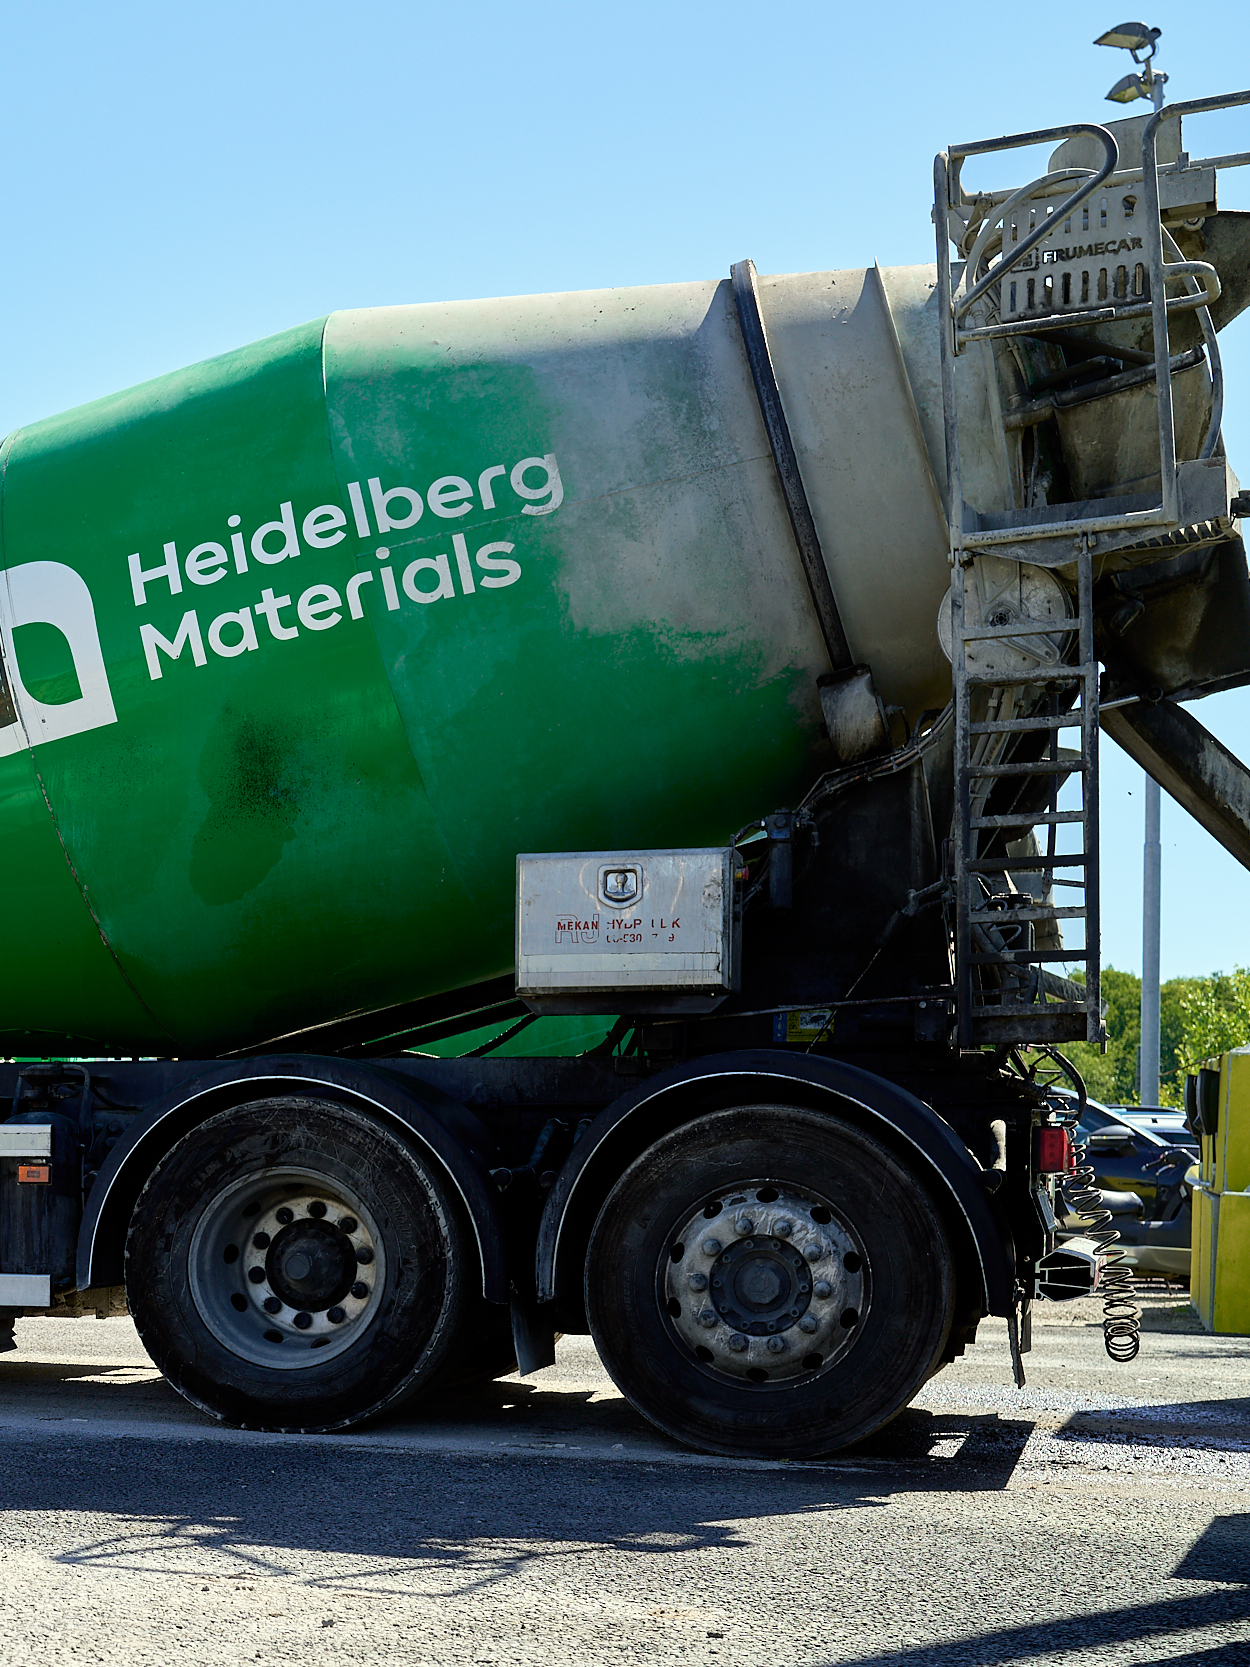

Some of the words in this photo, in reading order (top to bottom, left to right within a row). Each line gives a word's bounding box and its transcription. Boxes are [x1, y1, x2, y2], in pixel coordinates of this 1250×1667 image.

[1043, 237, 1143, 264] FRUMECAR
[128, 453, 564, 606] Heidelberg
[139, 533, 522, 680] Materials
[557, 920, 599, 931] MEKAN
